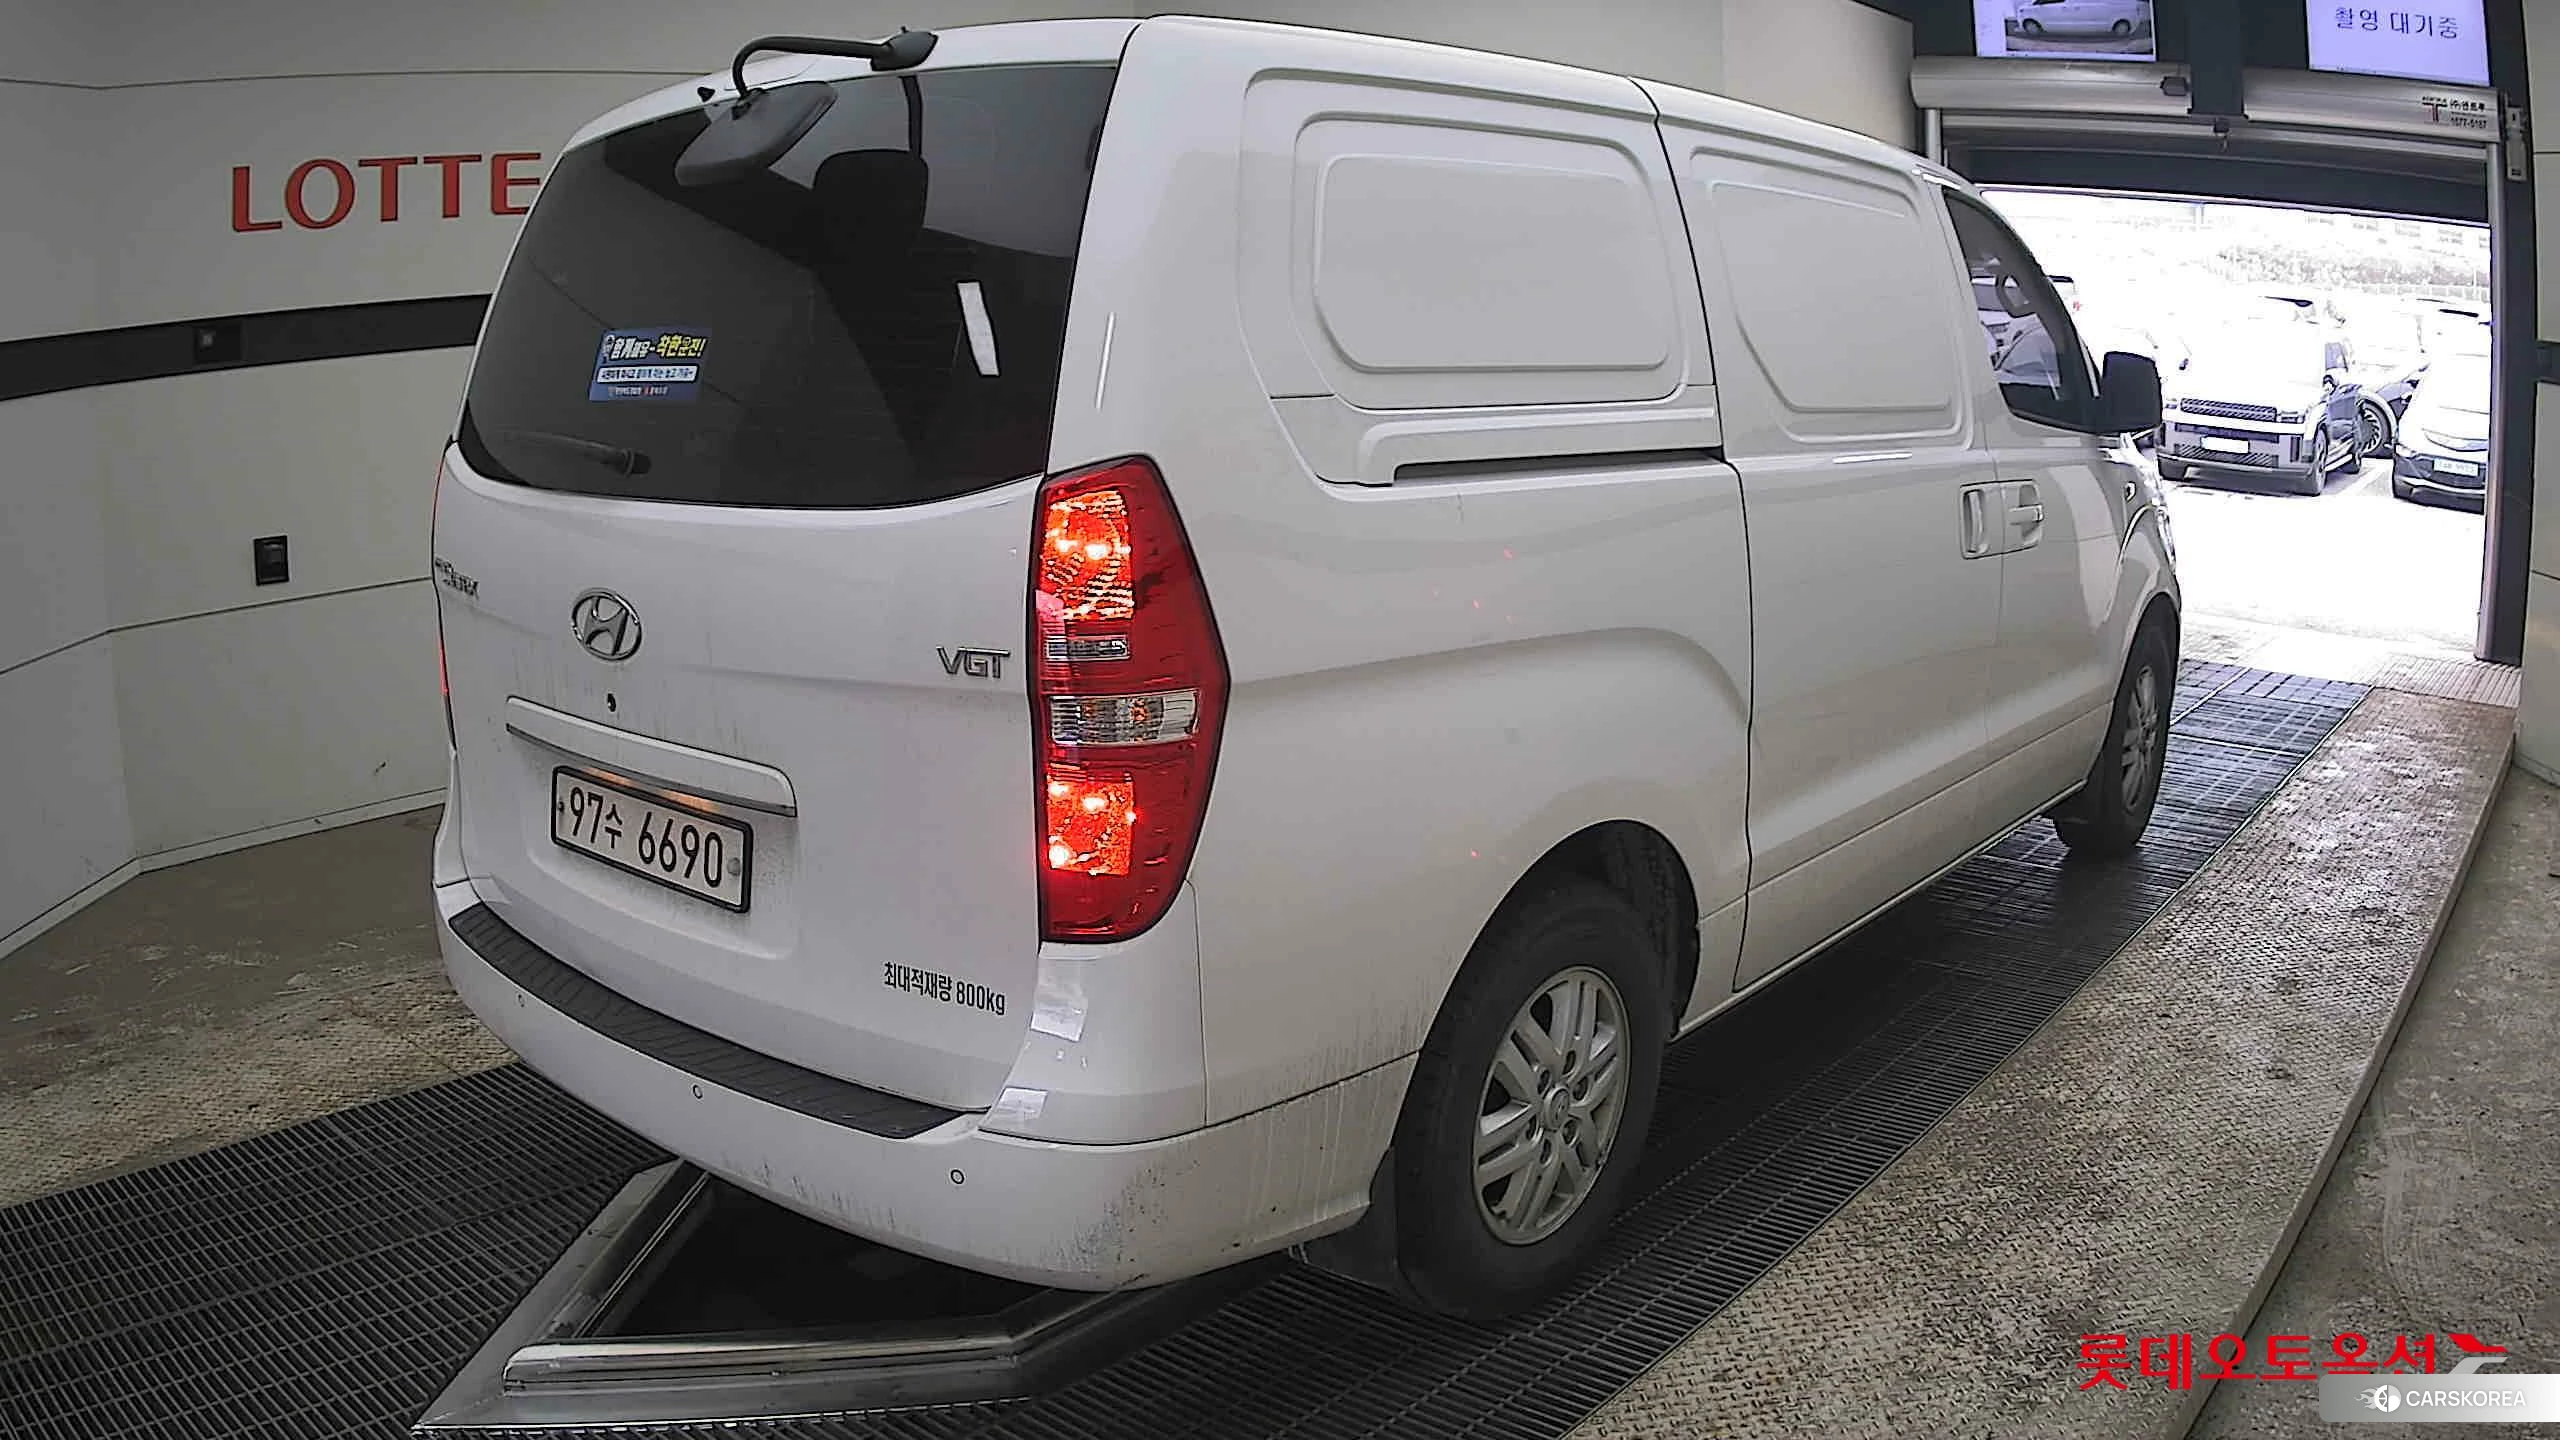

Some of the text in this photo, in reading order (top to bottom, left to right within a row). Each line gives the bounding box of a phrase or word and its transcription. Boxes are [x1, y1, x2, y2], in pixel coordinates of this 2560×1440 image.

[2335, 6, 2459, 39] 촬영 대기중
[232, 152, 542, 233] LOTTE
[935, 645, 1011, 679] VGT
[569, 786, 723, 888] 97수 6690
[883, 961, 1006, 1016] 최대적재량 800kg
